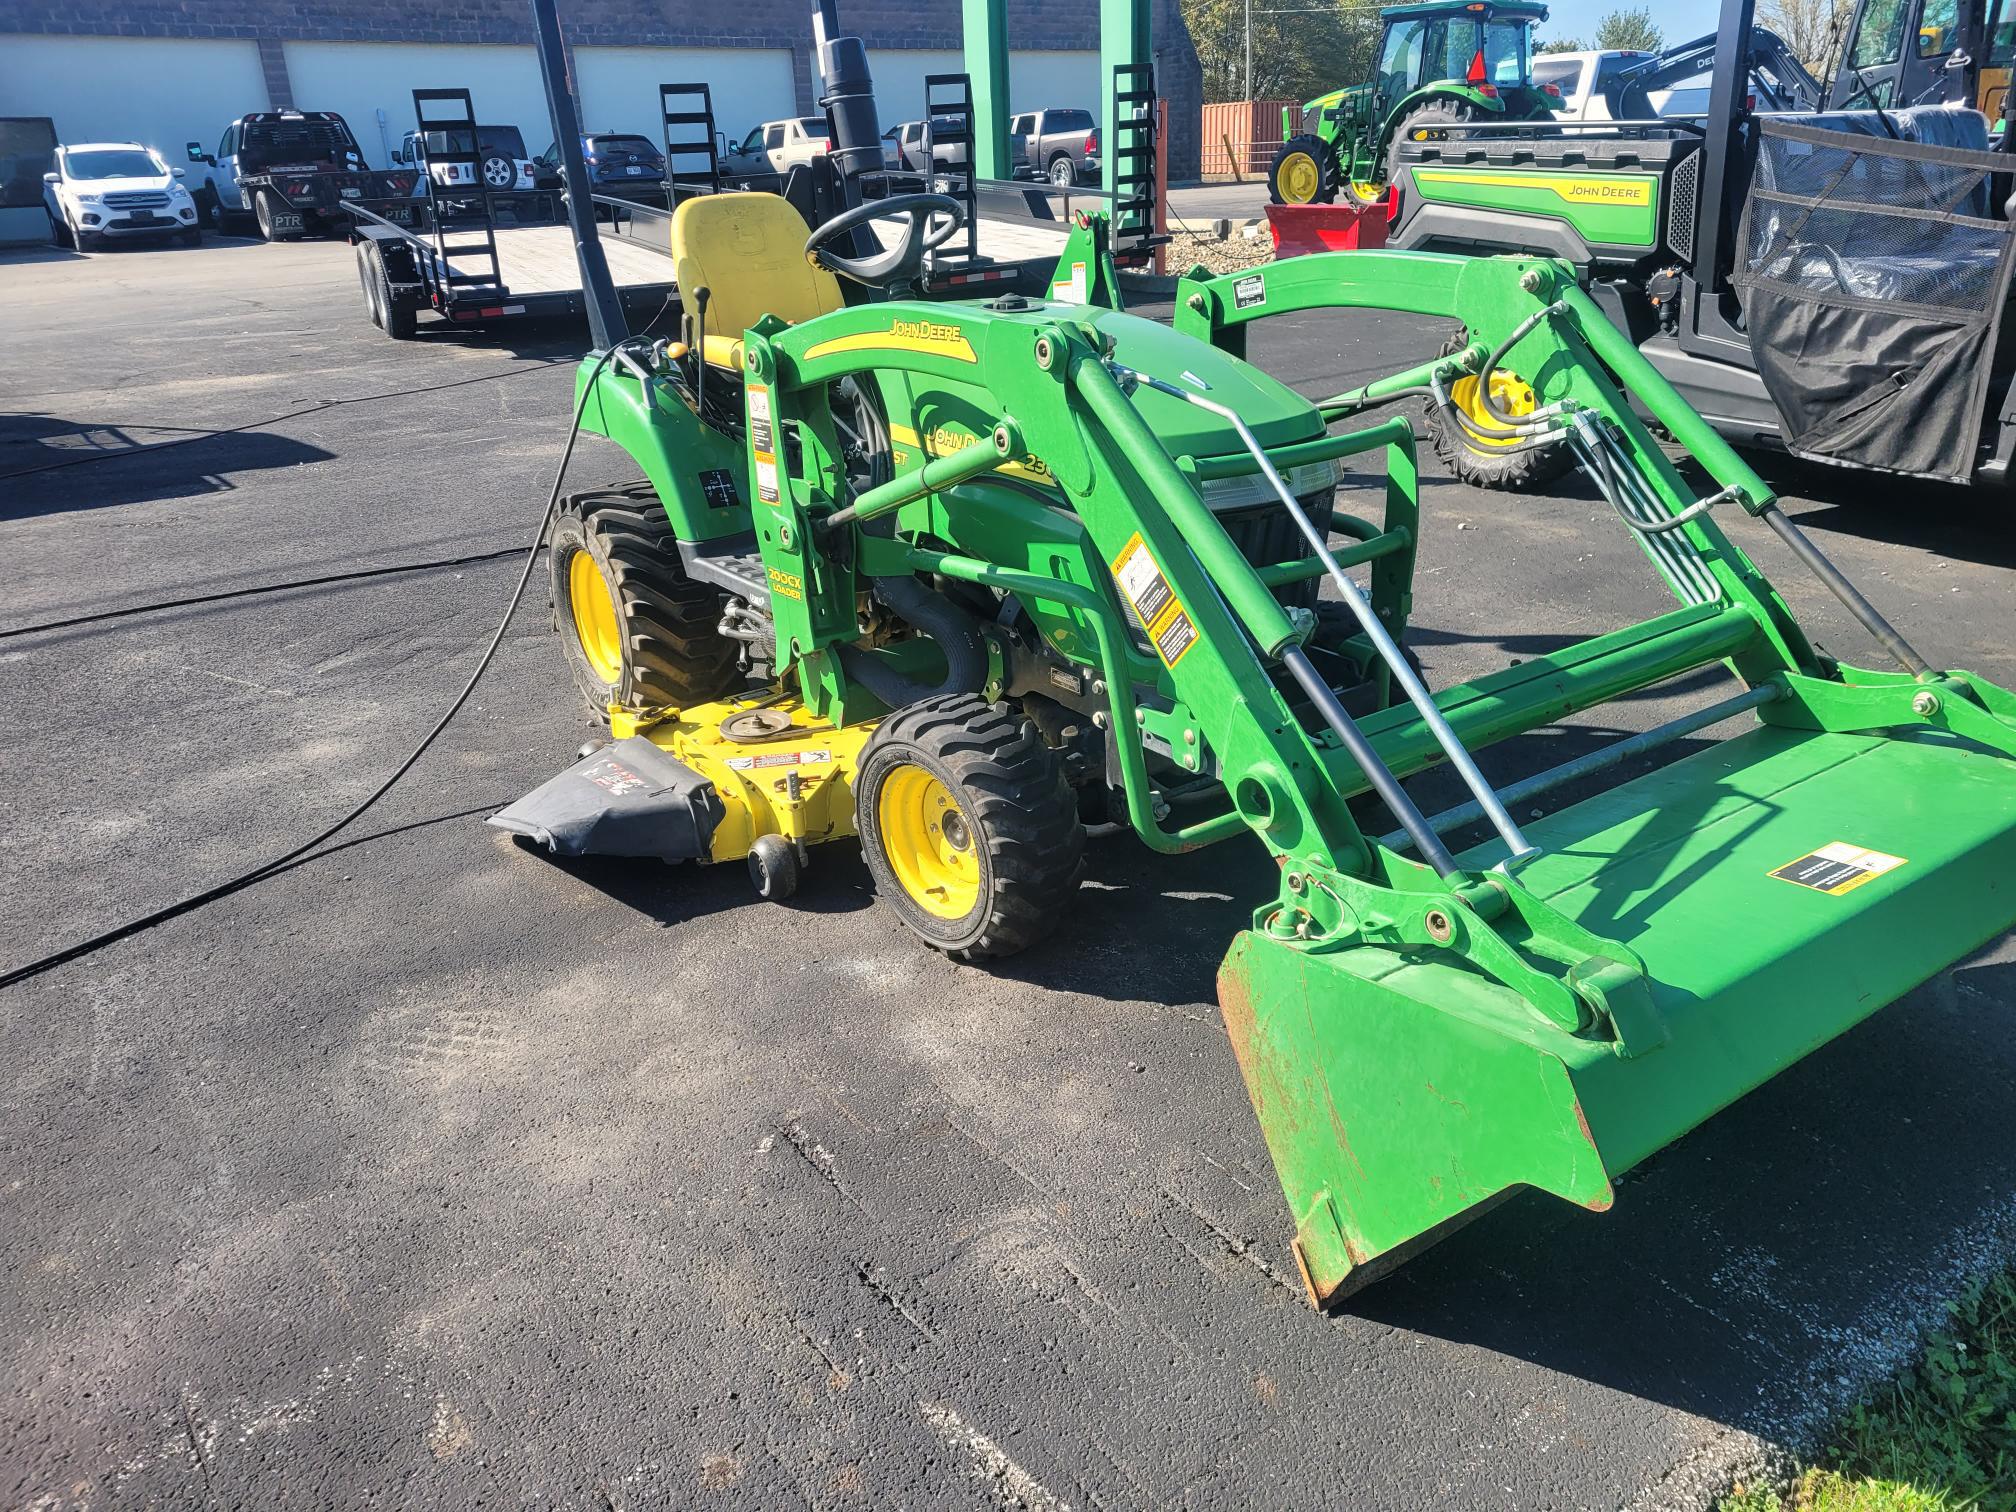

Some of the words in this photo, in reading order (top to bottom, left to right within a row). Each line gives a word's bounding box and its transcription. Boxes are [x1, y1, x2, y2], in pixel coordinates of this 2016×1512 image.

[1569, 184, 1600, 196] JOHN
[1601, 186, 1641, 198] DEERE
[275, 215, 302, 227] PTR
[385, 209, 409, 219] PTR
[890, 318, 920, 338] JOHN
[920, 320, 961, 342] DEERE
[928, 424, 963, 449] JOHN
[1120, 539, 1139, 565] WARNING
[772, 582, 802, 601] LOADER
[1159, 606, 1180, 631] WARNING
